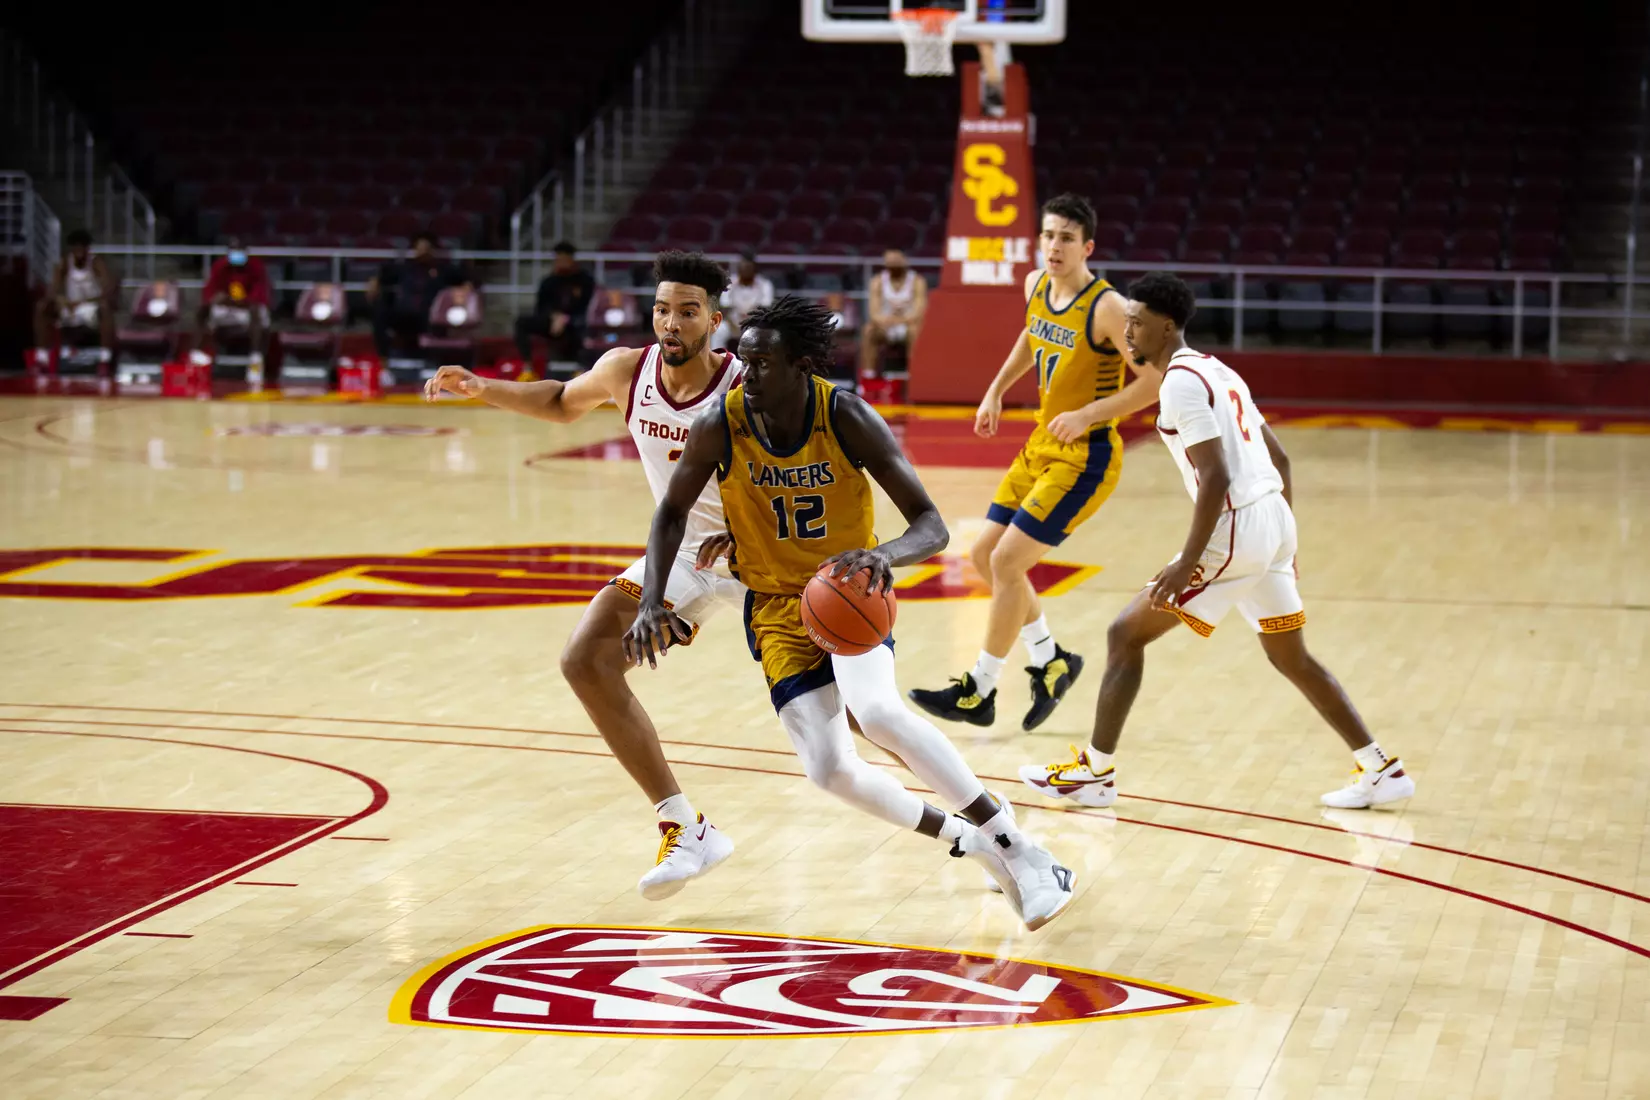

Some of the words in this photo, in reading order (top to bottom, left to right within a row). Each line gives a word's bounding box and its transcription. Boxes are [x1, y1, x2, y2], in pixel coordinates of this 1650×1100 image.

[962, 143, 1018, 226] SC
[1029, 315, 1077, 349] LANCERS
[644, 384, 653, 400] C
[1033, 347, 1061, 393] 11
[1227, 388, 1252, 442] 2
[746, 461, 836, 489] LANCERS
[771, 493, 828, 540] 12
